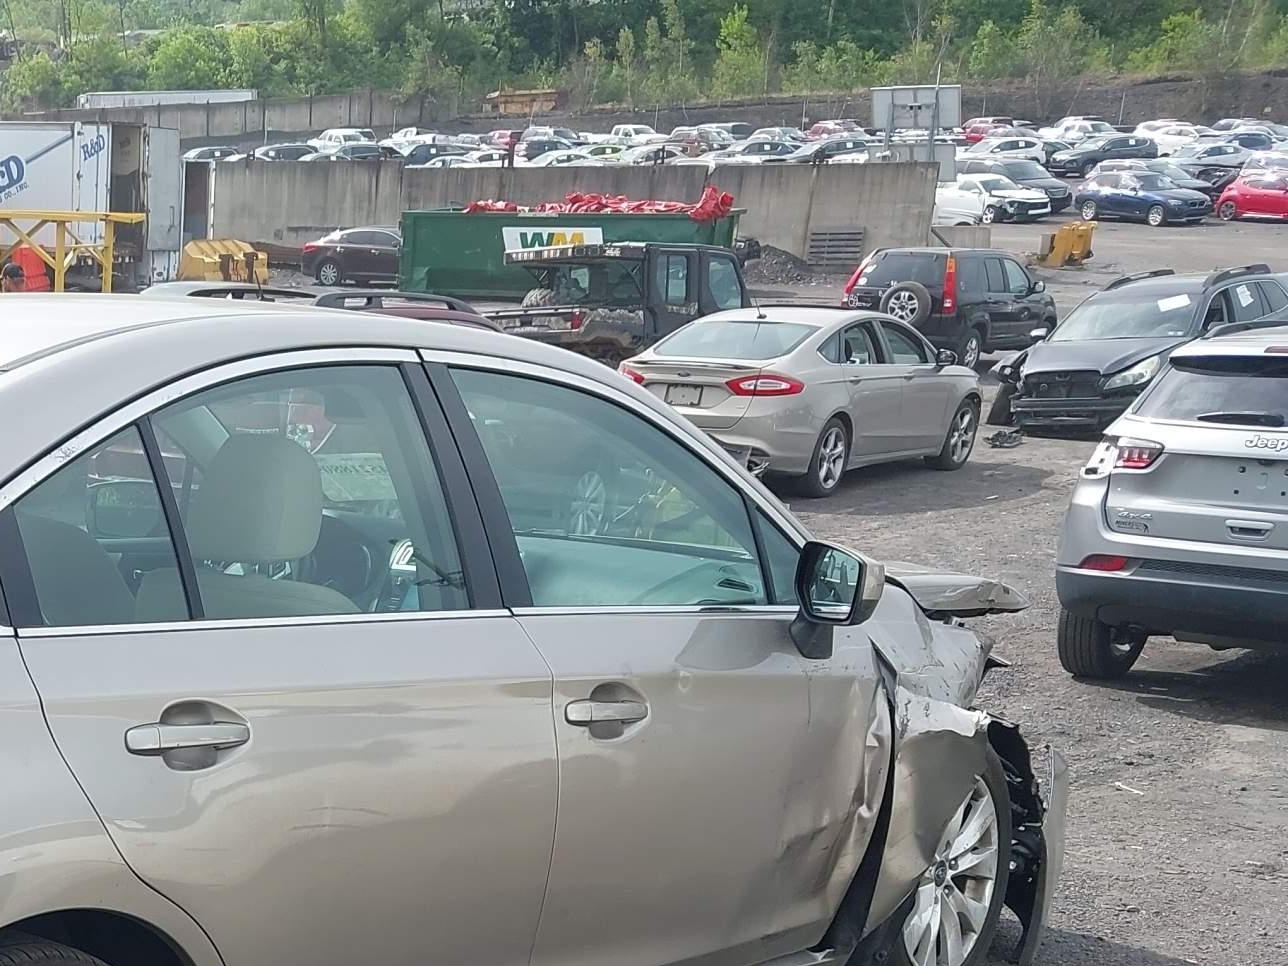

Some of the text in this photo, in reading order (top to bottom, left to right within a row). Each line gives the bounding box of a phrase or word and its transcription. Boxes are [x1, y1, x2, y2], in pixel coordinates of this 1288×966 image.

[81, 134, 106, 162] R&D
[519, 232, 584, 249] WM
[1244, 434, 1288, 452] Jeep
